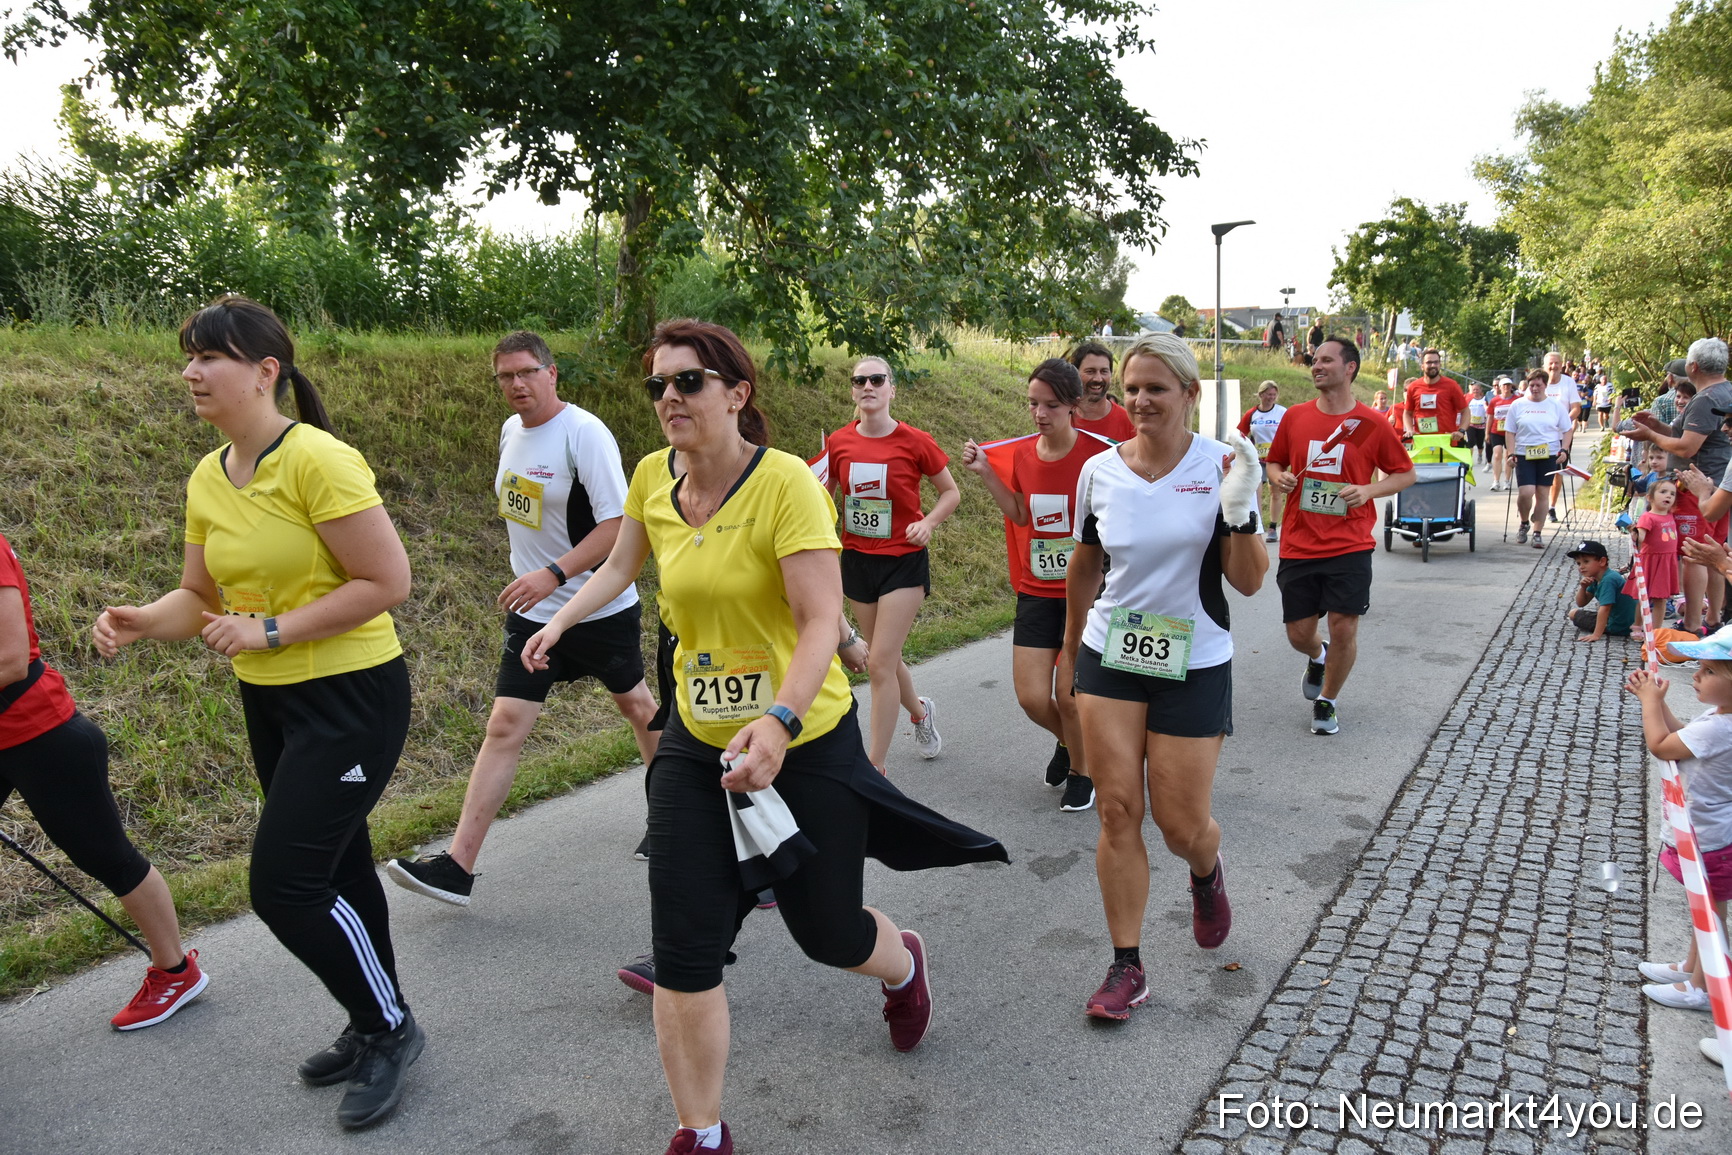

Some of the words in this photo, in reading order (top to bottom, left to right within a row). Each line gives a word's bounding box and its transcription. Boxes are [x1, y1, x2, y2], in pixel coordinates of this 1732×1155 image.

[1528, 447, 1546, 456] 1168
[507, 490, 531, 514] 960
[1310, 491, 1338, 506] 517
[852, 511, 879, 528] 538
[1038, 553, 1067, 569] 516
[1122, 632, 1171, 660] 963
[1120, 653, 1140, 663] Metka
[1140, 657, 1169, 668] Susanne
[749, 665, 769, 673] 2019
[692, 673, 762, 705] 2197
[702, 706, 729, 714] Ruppert
[730, 703, 760, 712] Monika
